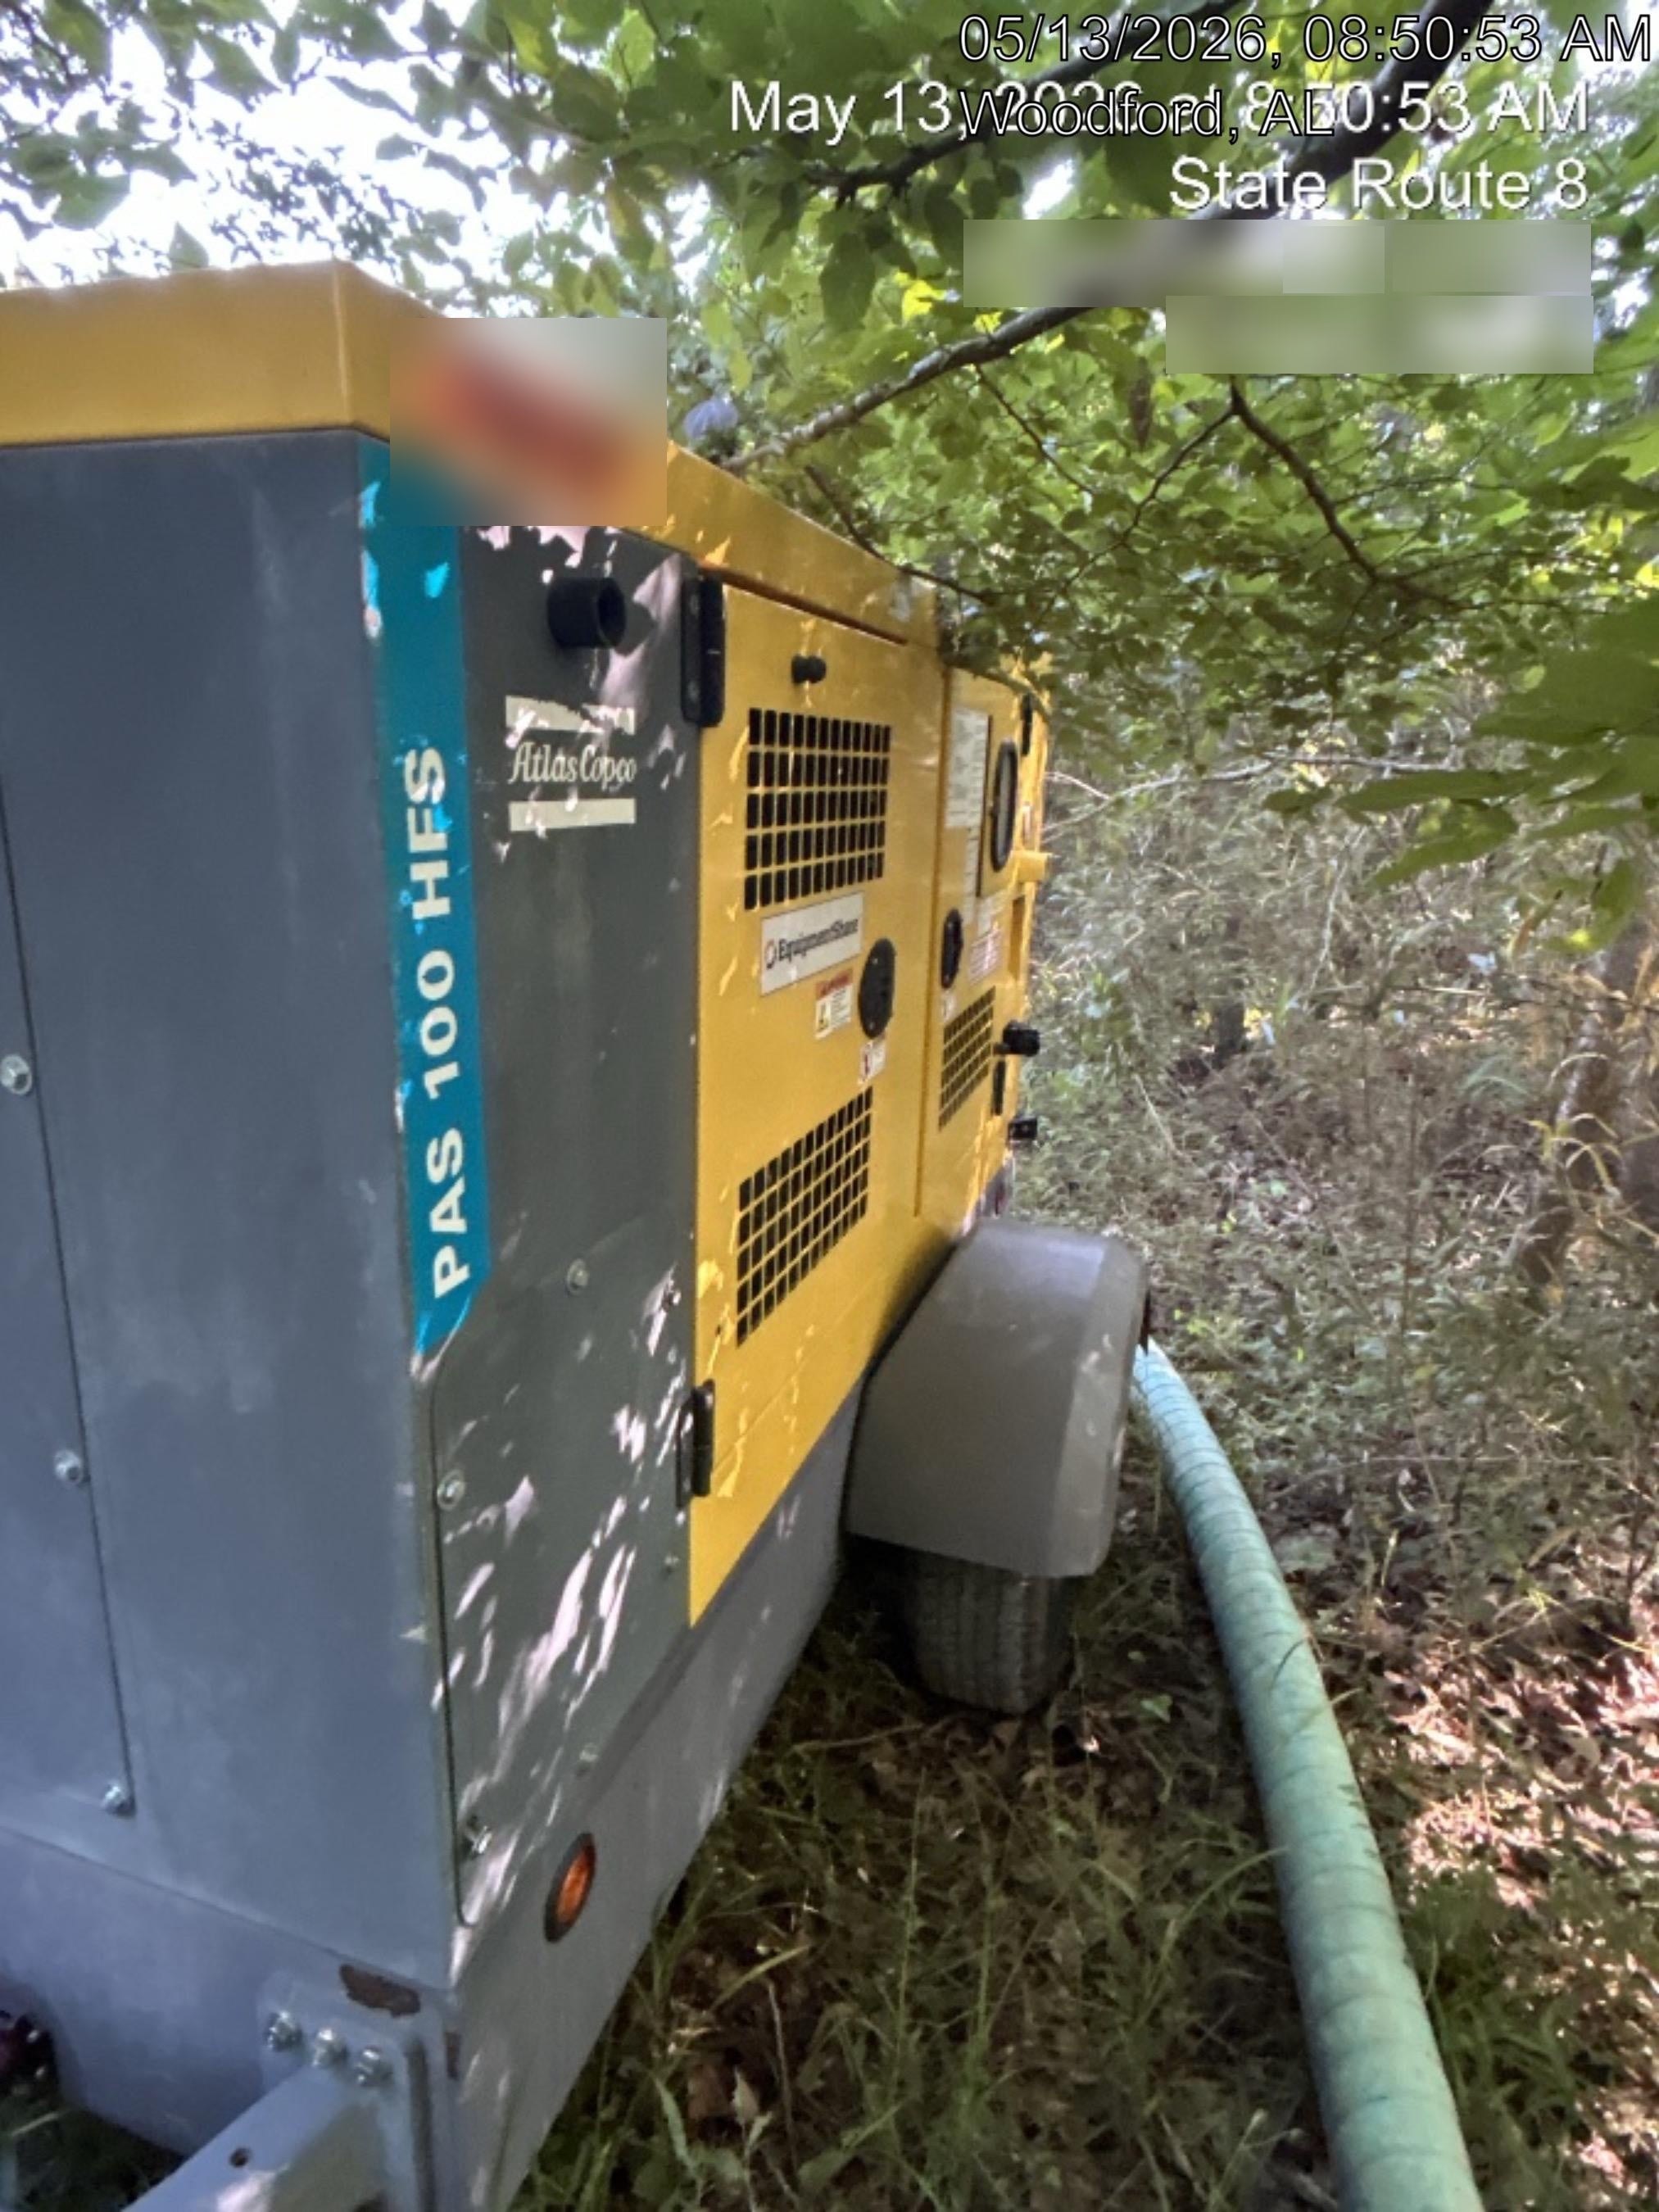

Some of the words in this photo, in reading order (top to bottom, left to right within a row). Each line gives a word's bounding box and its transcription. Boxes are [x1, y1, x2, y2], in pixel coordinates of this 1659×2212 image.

[404, 746, 452, 921] HFS
[507, 741, 578, 785] Atlas
[579, 743, 637, 792] Copco
[416, 949, 460, 1099] 100
[425, 1126, 469, 1299] PAS
